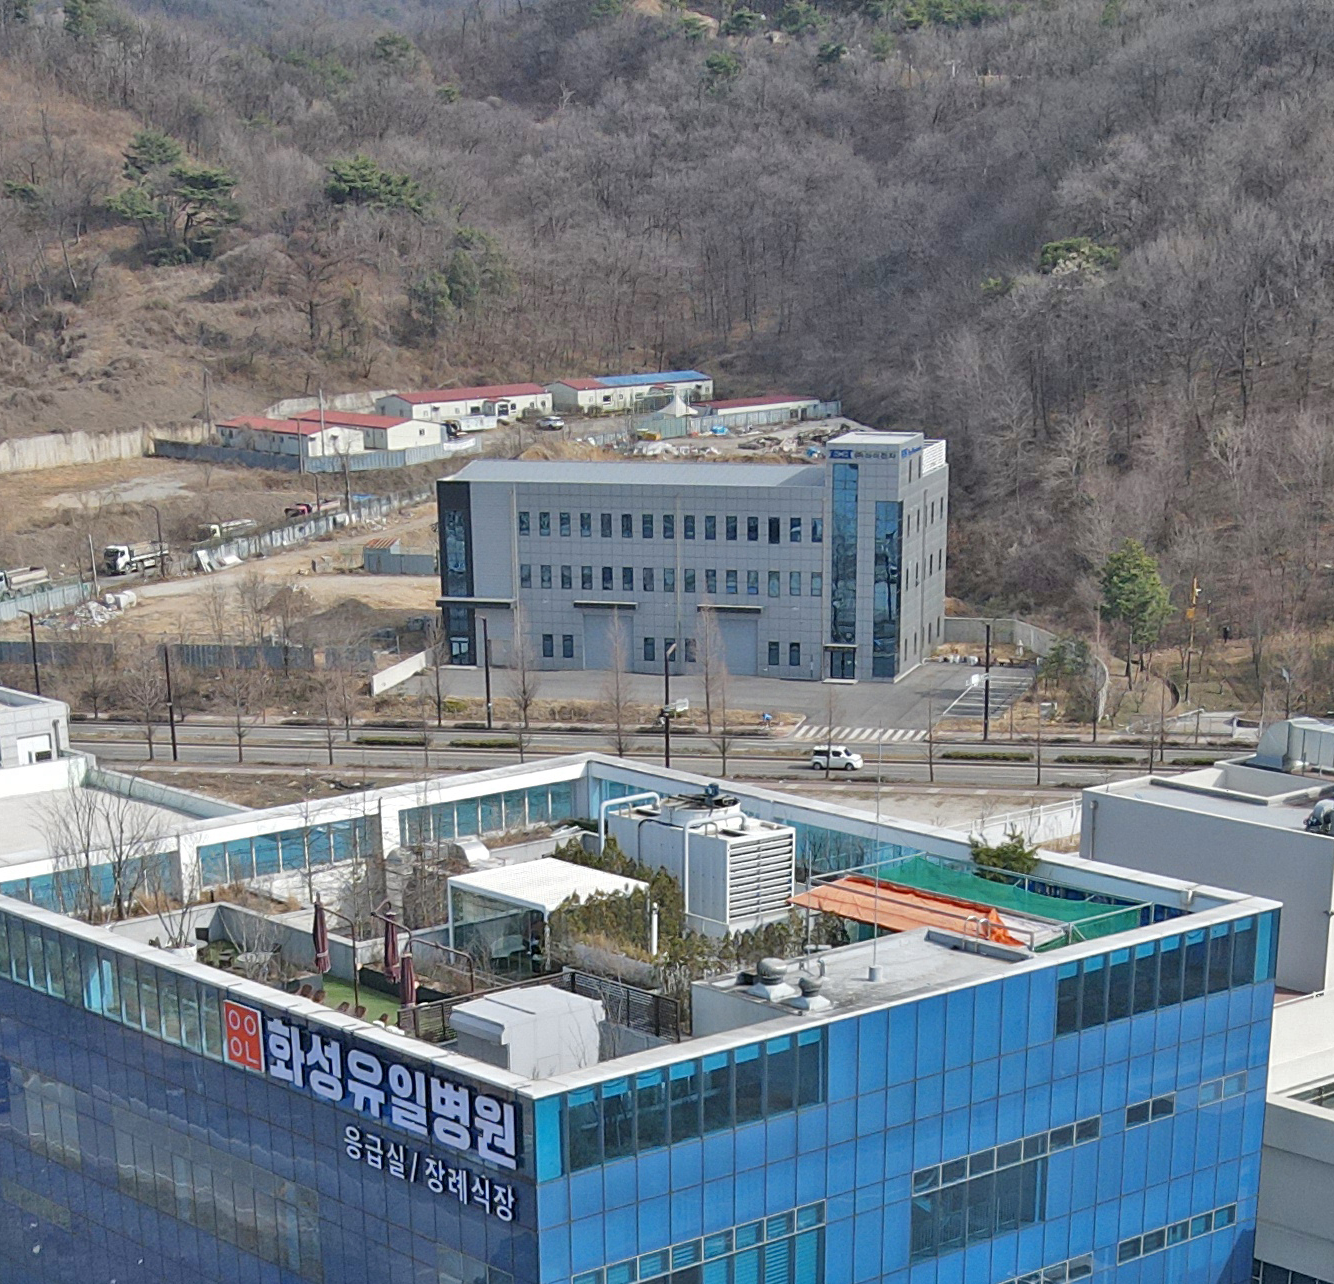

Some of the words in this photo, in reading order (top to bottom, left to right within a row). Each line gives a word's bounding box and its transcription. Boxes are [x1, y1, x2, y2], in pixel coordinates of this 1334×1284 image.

[267, 1018, 517, 1170] 화성유일병원
[344, 1126, 405, 1180] 응급실
[425, 1155, 515, 1222] 장례식장
